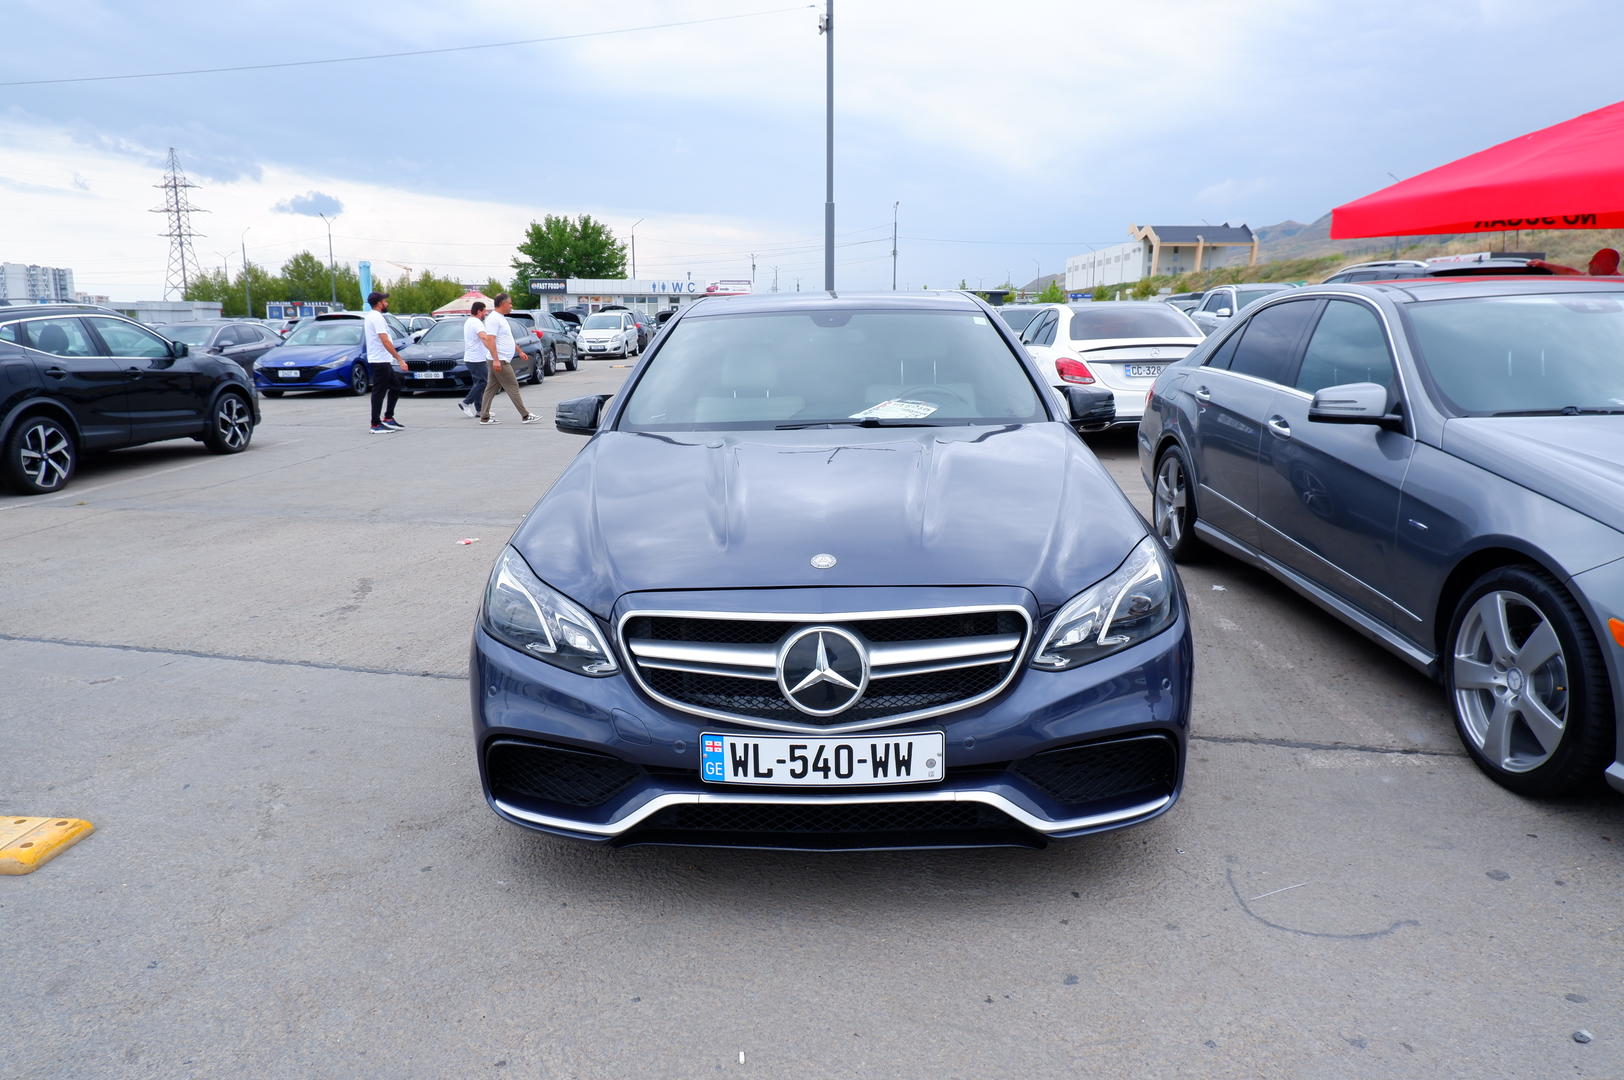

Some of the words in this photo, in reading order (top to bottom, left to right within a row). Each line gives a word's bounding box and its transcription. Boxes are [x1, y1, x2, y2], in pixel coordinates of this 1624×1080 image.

[536, 282, 547, 290] FAST
[548, 282, 560, 290] FOOD
[730, 742, 913, 780] WL-540-WW
[705, 762, 723, 776] GE
